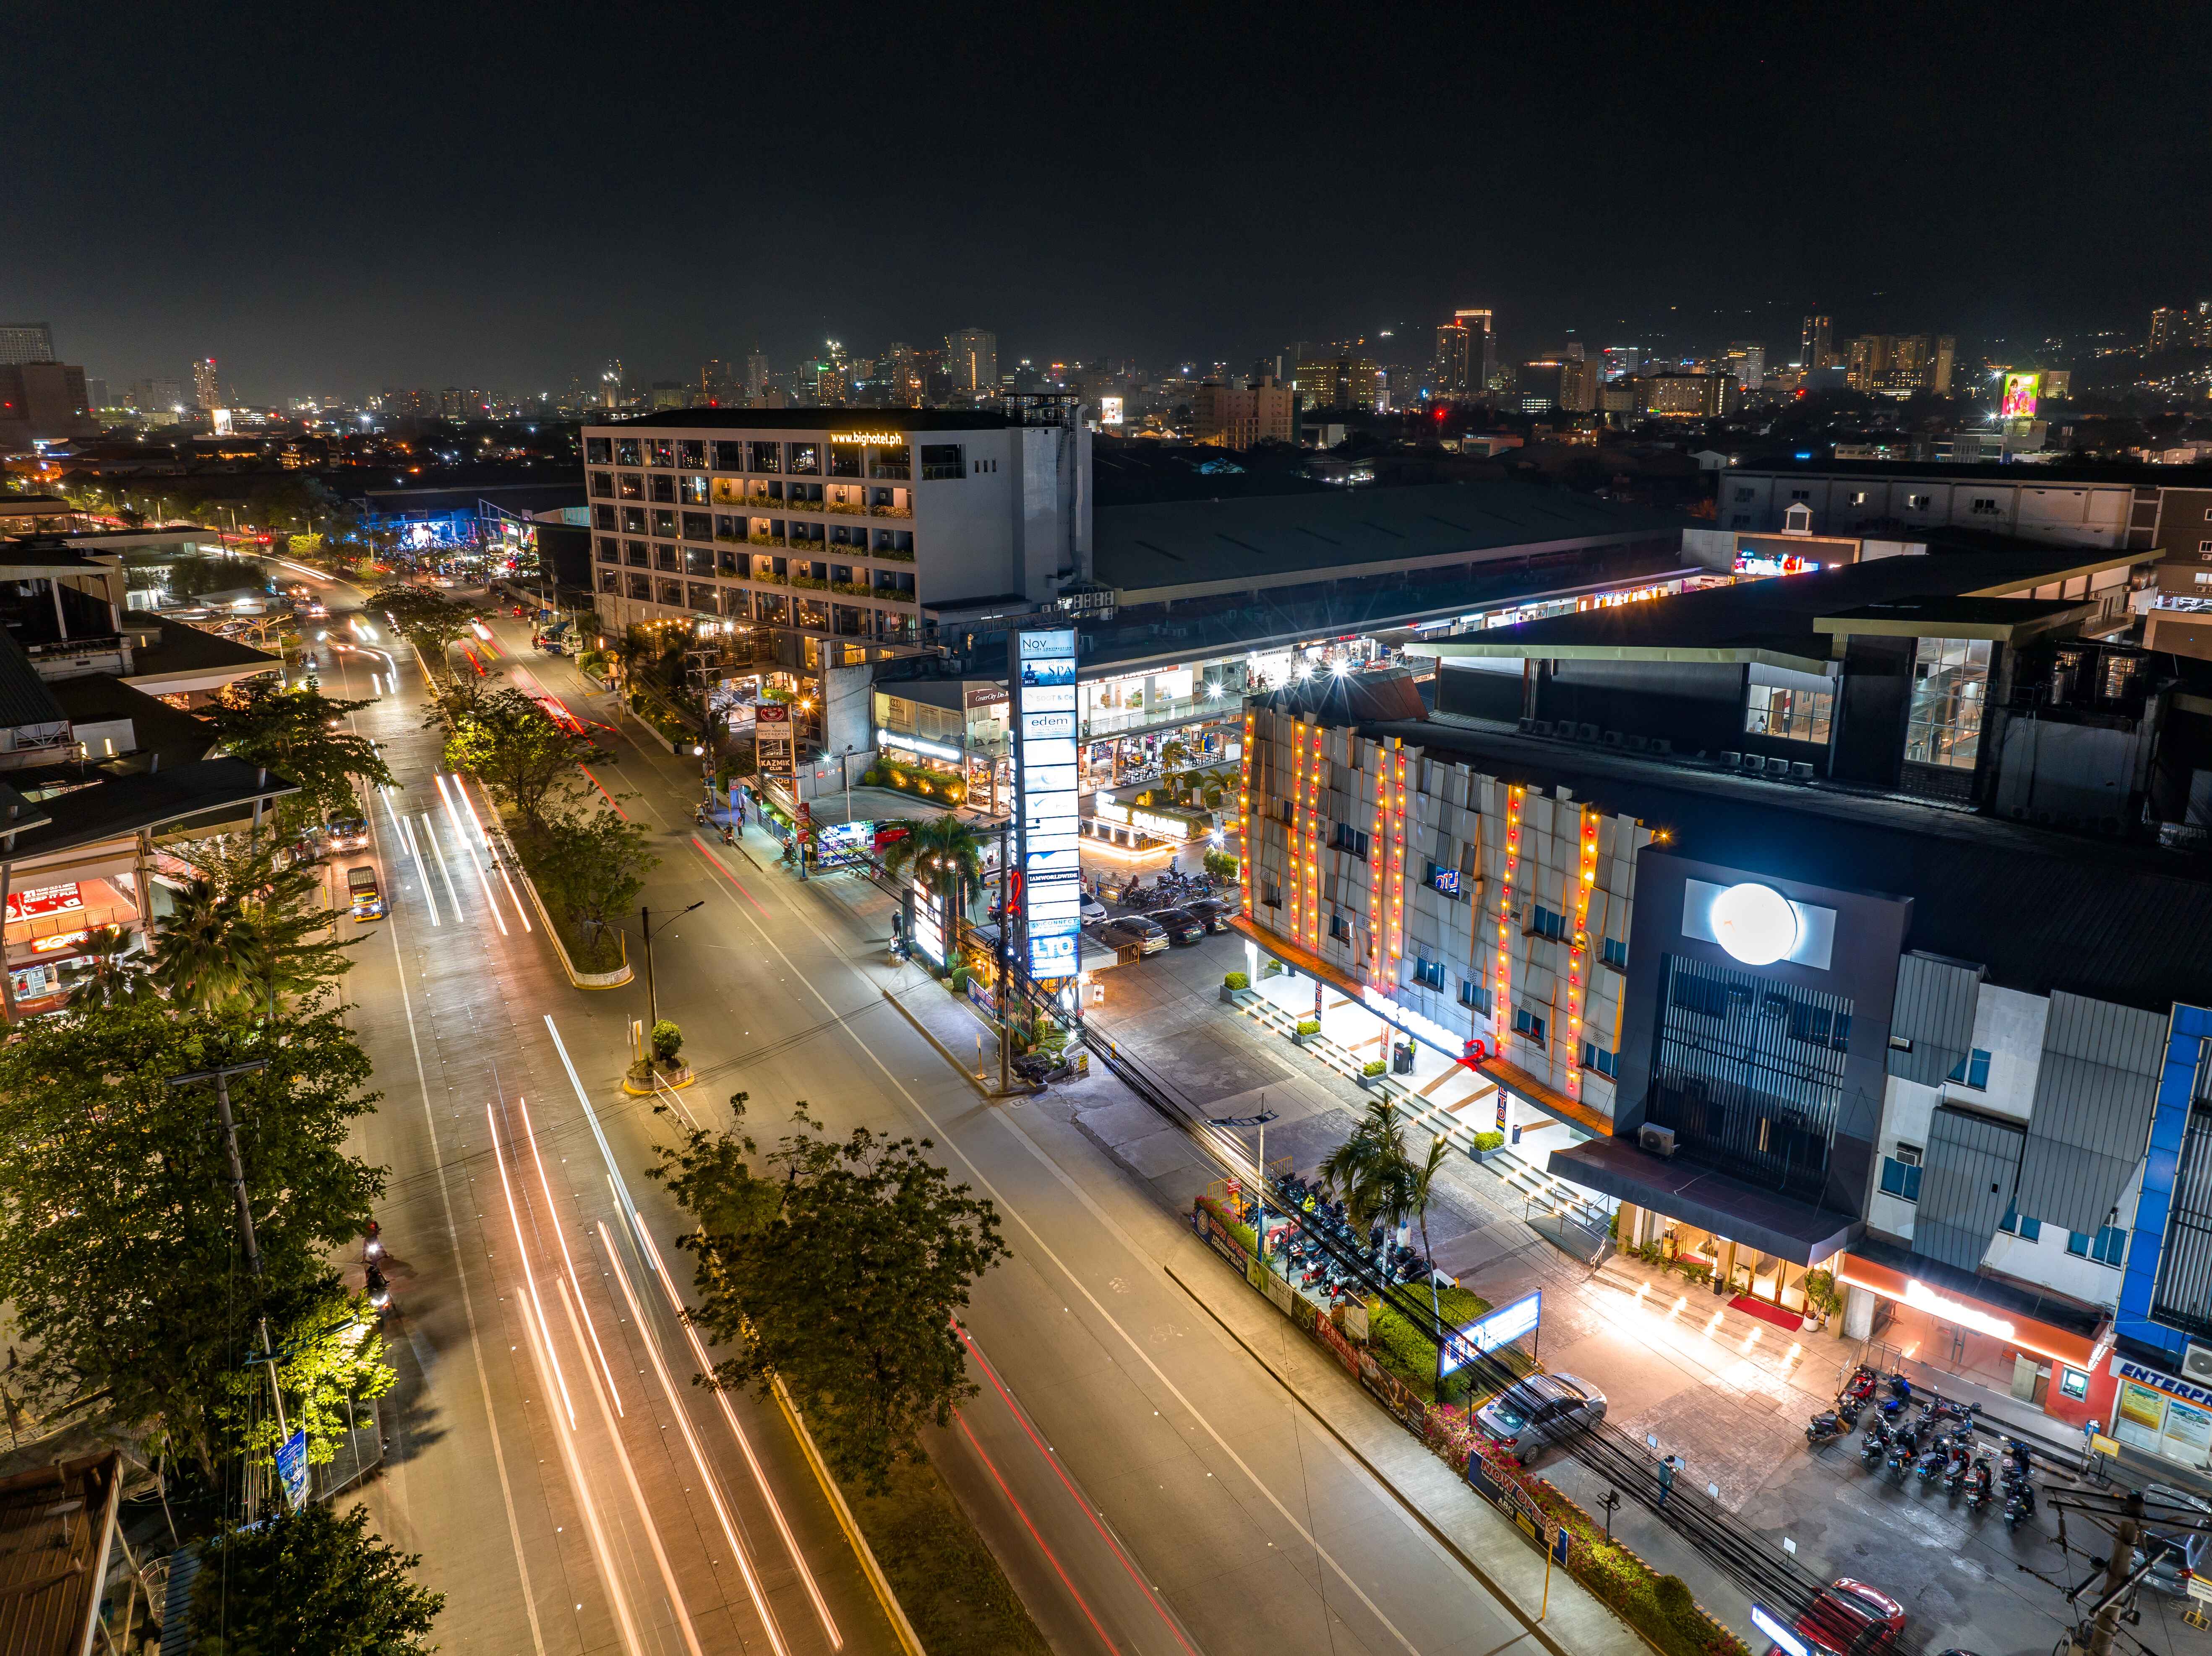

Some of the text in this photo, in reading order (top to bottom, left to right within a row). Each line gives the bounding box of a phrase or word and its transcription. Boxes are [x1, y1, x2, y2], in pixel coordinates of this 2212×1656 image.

[831, 432, 902, 447] www.bighotel.ph
[1048, 665, 1074, 677] SPA
[975, 693, 996, 702] CenterCity
[1031, 716, 1067, 726] edem
[1029, 873, 1078, 881] IAMWORLDWIDE
[23, 890, 36, 898] 21
[1100, 892, 1118, 901] INSIDE
[1033, 937, 1074, 958] LTO
[1209, 1217, 1227, 1240] NOW
[1211, 1238, 1245, 1273] LICENSING CENTER
[1220, 1241, 1236, 1258] MANDAUE
[1481, 1459, 1516, 1493] NOW
[1482, 1471, 1498, 1487] Located
[1512, 1496, 1523, 1508] Floor
[1497, 1497, 1514, 1515] ABG
